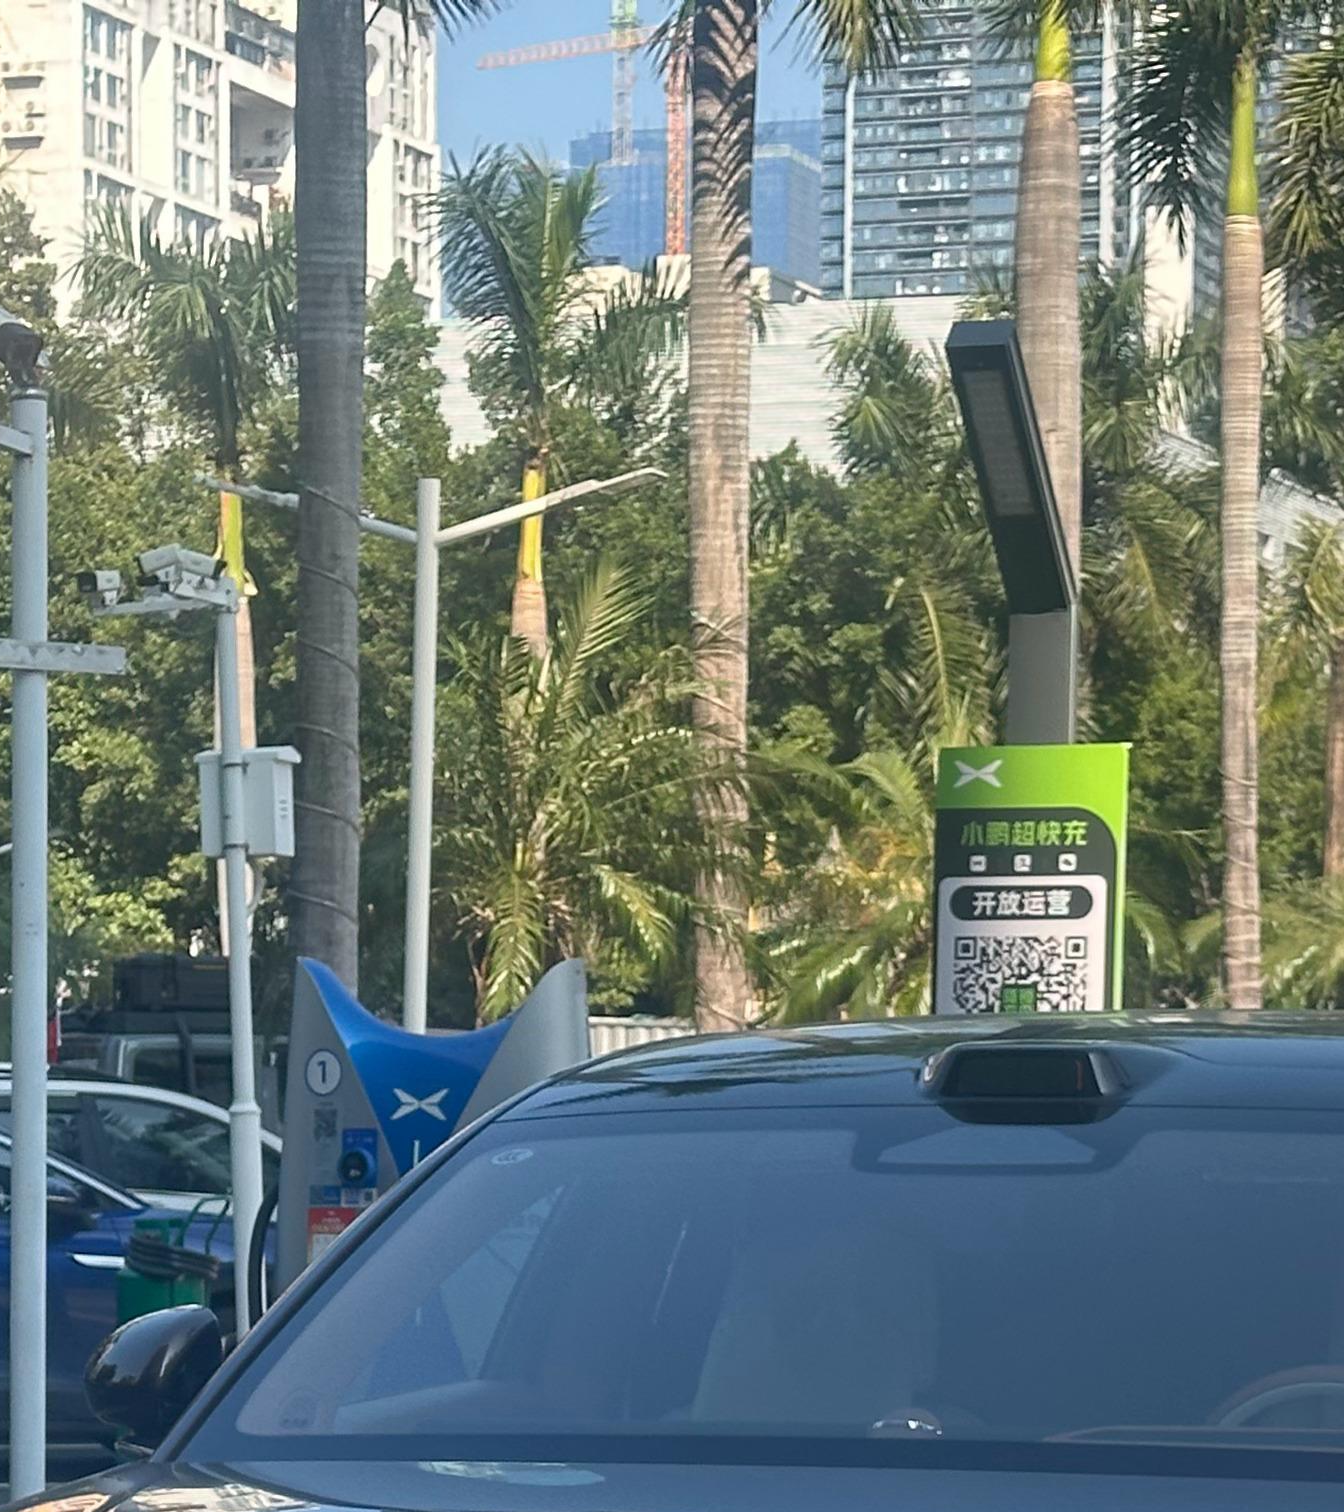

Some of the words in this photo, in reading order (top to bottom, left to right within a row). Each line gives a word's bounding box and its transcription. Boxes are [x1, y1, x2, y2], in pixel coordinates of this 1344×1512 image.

[960, 820, 1088, 847] 小鹏超快充
[971, 889, 1073, 917] 开放运营
[316, 1059, 327, 1085] 1
